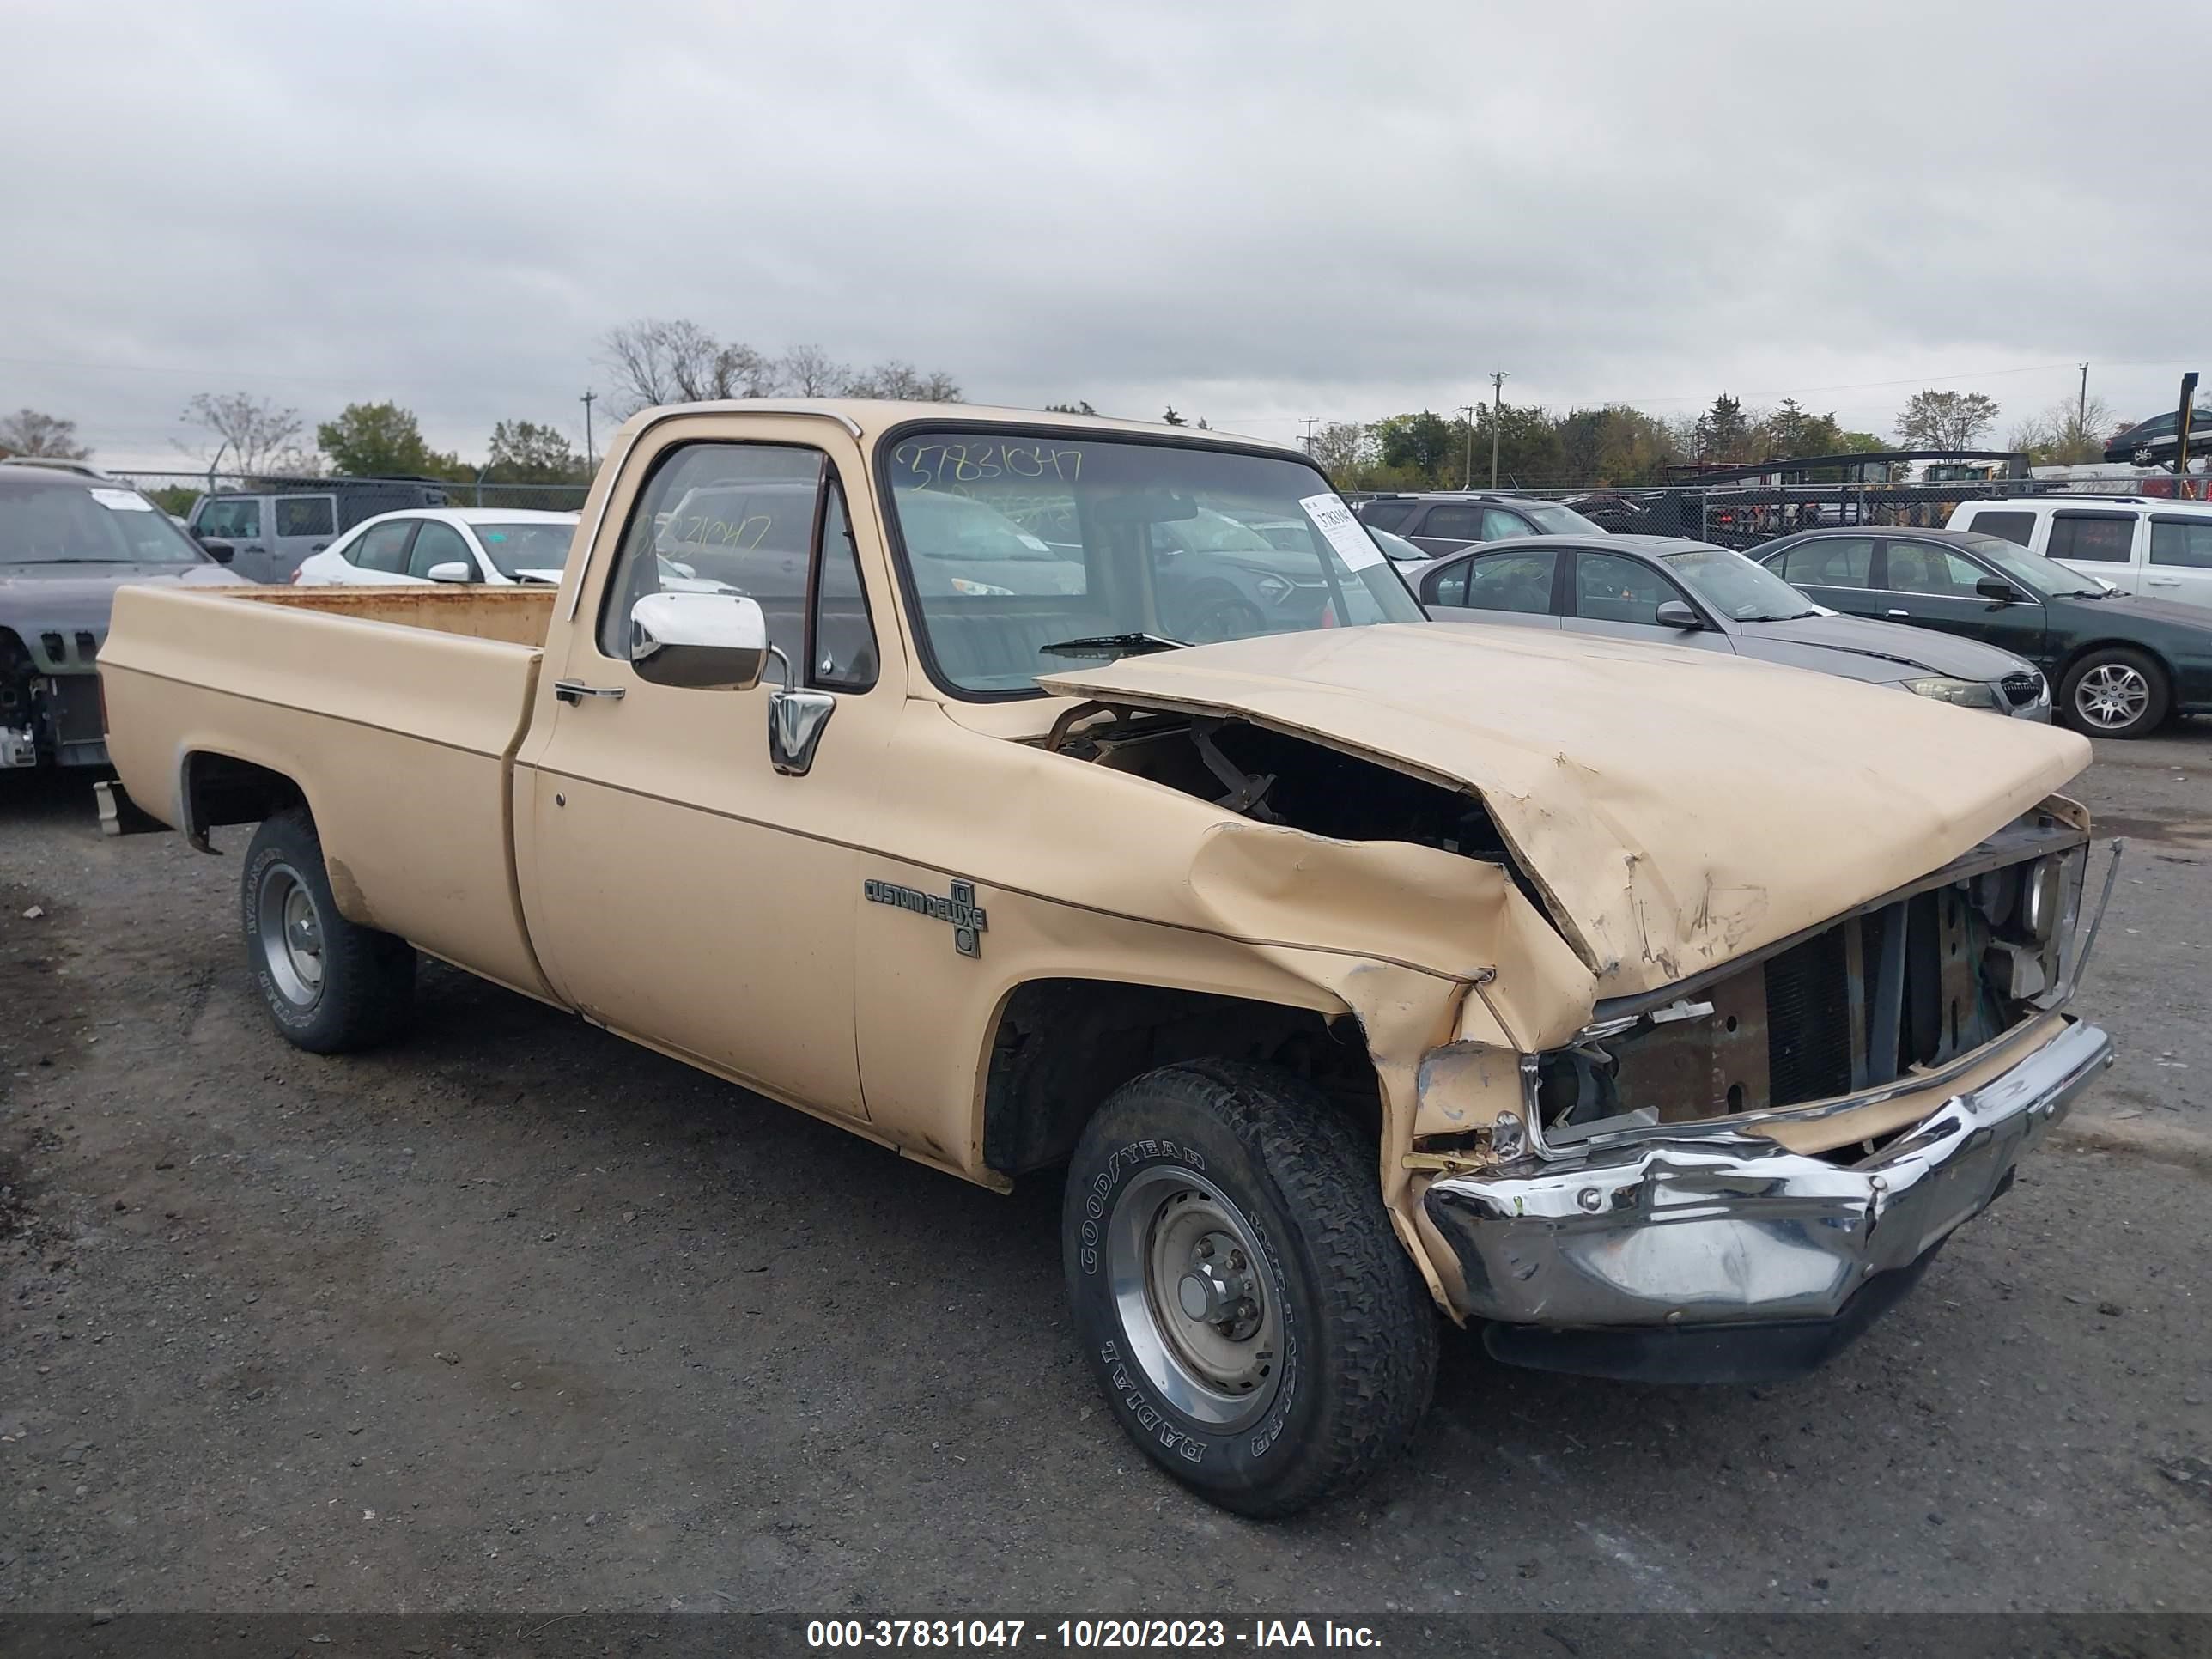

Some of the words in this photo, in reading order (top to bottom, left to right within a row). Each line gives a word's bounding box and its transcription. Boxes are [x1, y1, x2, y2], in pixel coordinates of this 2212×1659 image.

[896, 443, 1082, 492] 37831047
[864, 878, 926, 914] CUSTOM
[1100, 1340, 1208, 1465] RADIAL
